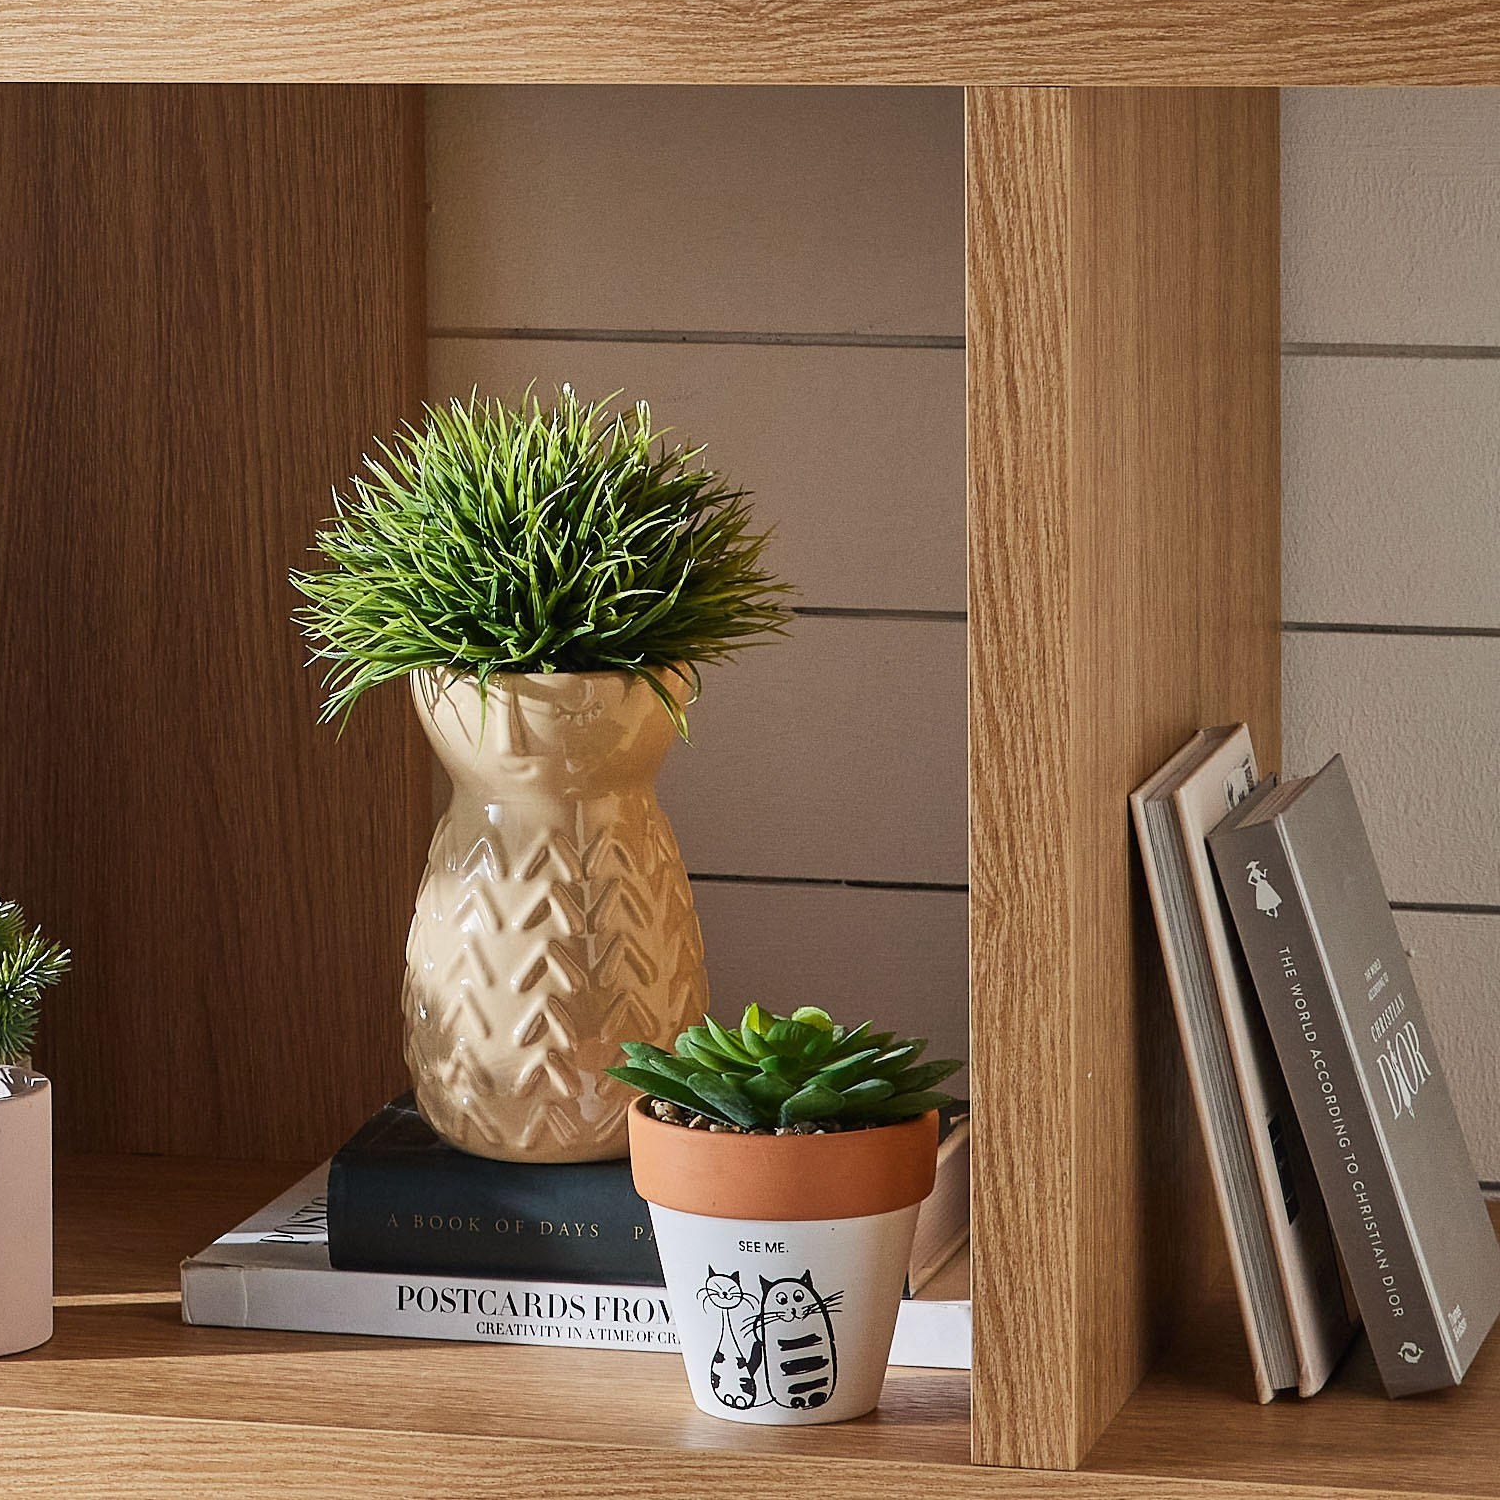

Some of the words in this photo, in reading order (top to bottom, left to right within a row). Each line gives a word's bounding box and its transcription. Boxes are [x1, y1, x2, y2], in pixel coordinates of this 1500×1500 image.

[1370, 992, 1406, 1043] CHRISTIAN
[1278, 946, 1298, 978] THE
[1290, 983, 1318, 1042] WORLD
[1310, 1049, 1351, 1148] ACCORDING
[1344, 1153, 1359, 1174] TO
[1352, 1180, 1390, 1269] CHRISTIAN
[1382, 1275, 1405, 1317] DIOR
[387, 1212, 399, 1228] A
[413, 1214, 481, 1232] BOOK
[495, 1218, 524, 1234] OF
[540, 1221, 600, 1238] DAYS
[738, 1240, 761, 1253] SEE
[764, 1241, 789, 1253] ME.
[396, 1284, 586, 1321] POSTCARDS
[476, 1321, 562, 1339] CREATIVITY
[568, 1326, 583, 1340] IN
[586, 1327, 597, 1341] A
[598, 1327, 634, 1343] TIME
[636, 1329, 656, 1344] OF
[657, 1331, 682, 1344] CR
